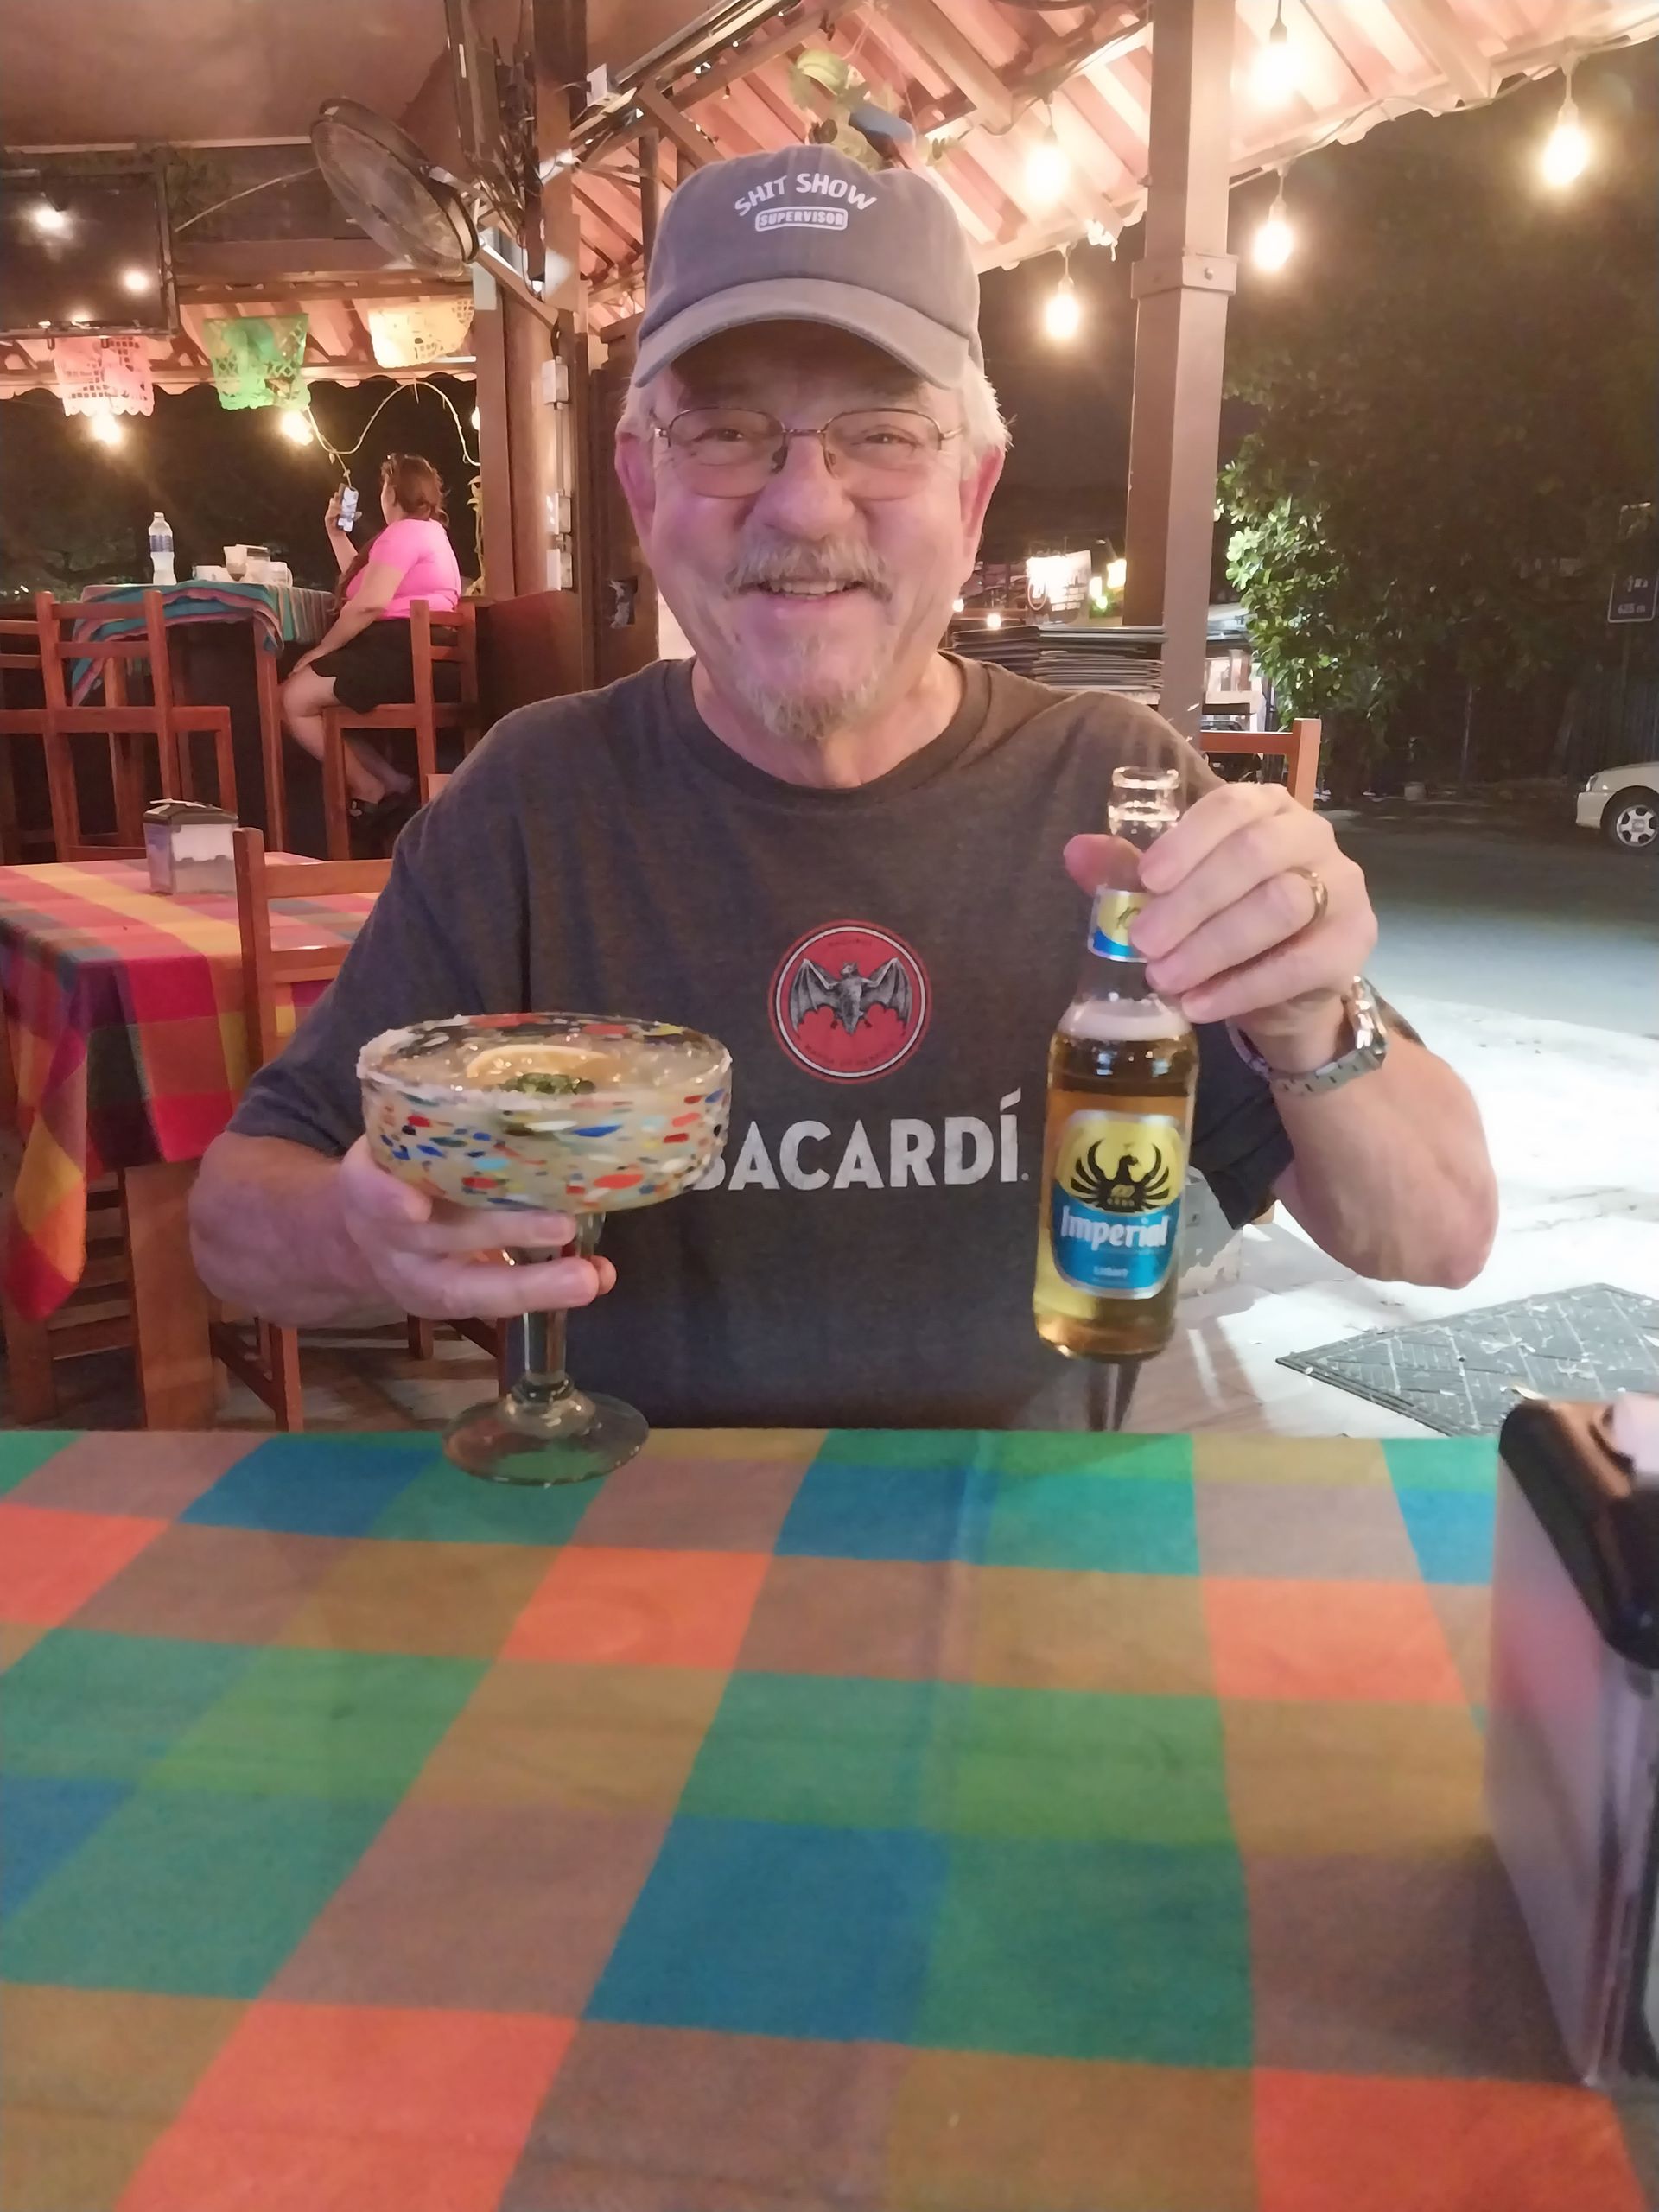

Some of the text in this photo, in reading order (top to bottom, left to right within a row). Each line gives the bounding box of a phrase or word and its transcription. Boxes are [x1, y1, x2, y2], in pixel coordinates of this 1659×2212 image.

[734, 173, 877, 216] SHIT SHOW
[760, 210, 843, 227] SUPERVISOR
[1060, 1205, 1170, 1251] Imperial
